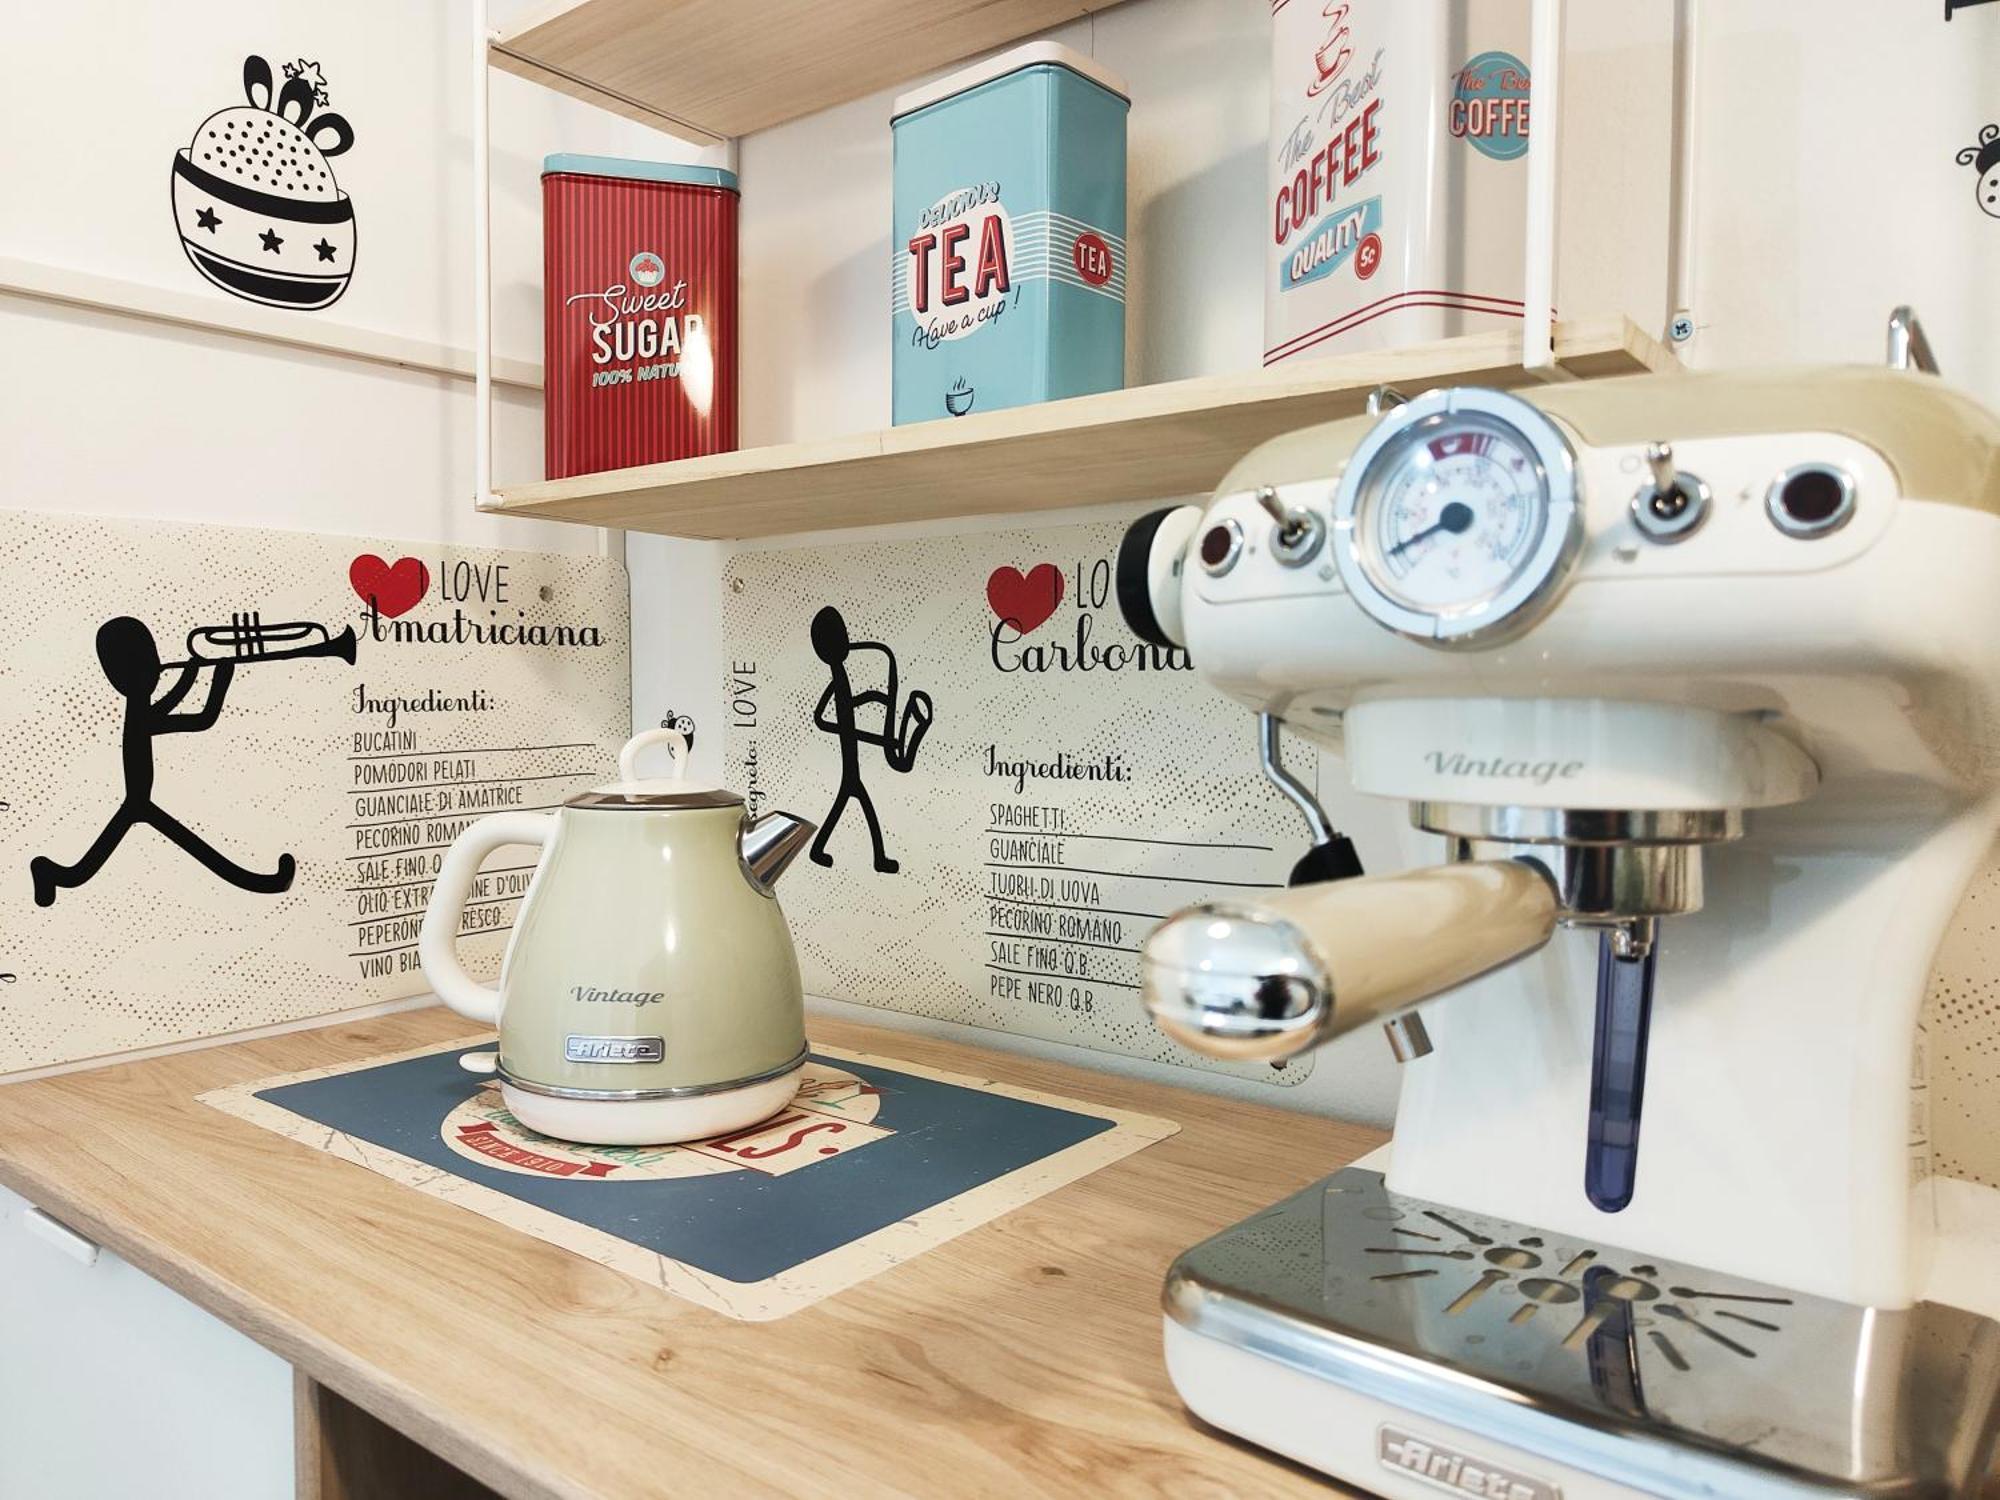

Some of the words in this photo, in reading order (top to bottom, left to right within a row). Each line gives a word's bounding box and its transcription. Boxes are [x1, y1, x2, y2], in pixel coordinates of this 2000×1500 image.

[1448, 98, 1529, 137] COFFE
[1275, 98, 1383, 245] COFFEE
[919, 180, 1000, 229] DELICIOUS
[1078, 243, 1107, 277] TEA
[1290, 205, 1369, 282] QUALITY
[909, 214, 1010, 313] TEA
[566, 279, 687, 326] Sweet
[912, 317, 958, 350] Have
[961, 311, 974, 325] a
[592, 369, 632, 387] 100%
[441, 561, 509, 603] LOVE
[1076, 559, 1110, 609] LO
[356, 593, 606, 647] Amatriciana
[988, 613, 1195, 673] Carbona
[352, 683, 495, 728] Ingredienti:
[733, 661, 757, 728] LOVE
[354, 731, 417, 752] BUCATINI
[355, 762, 428, 785] POMODORI
[434, 760, 476, 780] PELATI
[983, 744, 1131, 795] Ingredienti:
[1424, 751, 1584, 786] Vintage
[356, 792, 433, 817] GUANCIALE
[439, 791, 453, 811] DI
[458, 787, 523, 809] AMATRICE
[990, 803, 1064, 829] SPAGHETTI
[356, 824, 420, 850] PECORINO
[427, 819, 476, 842] ROMA
[990, 838, 1065, 865] GUANCIALE
[357, 860, 389, 883] SALE
[397, 855, 425, 877] FINO
[497, 873, 533, 895] D'OLIV
[358, 892, 388, 915] OLIO
[1041, 877, 1054, 899] DI
[1061, 879, 1100, 905] UOVA
[462, 906, 501, 930] RESCO
[990, 907, 1052, 935] PECORINO
[1059, 914, 1122, 944] ROMANO
[360, 955, 393, 979] VINO
[400, 951, 421, 973] BIA
[991, 941, 1021, 965] SALE
[1028, 946, 1057, 971] FINO
[570, 986, 664, 1007] Vintage
[991, 974, 1022, 1000] PEPE
[1028, 982, 1062, 1007] NERO
[568, 1042, 658, 1058] Ariete
[465, 1135, 514, 1157] SINCE
